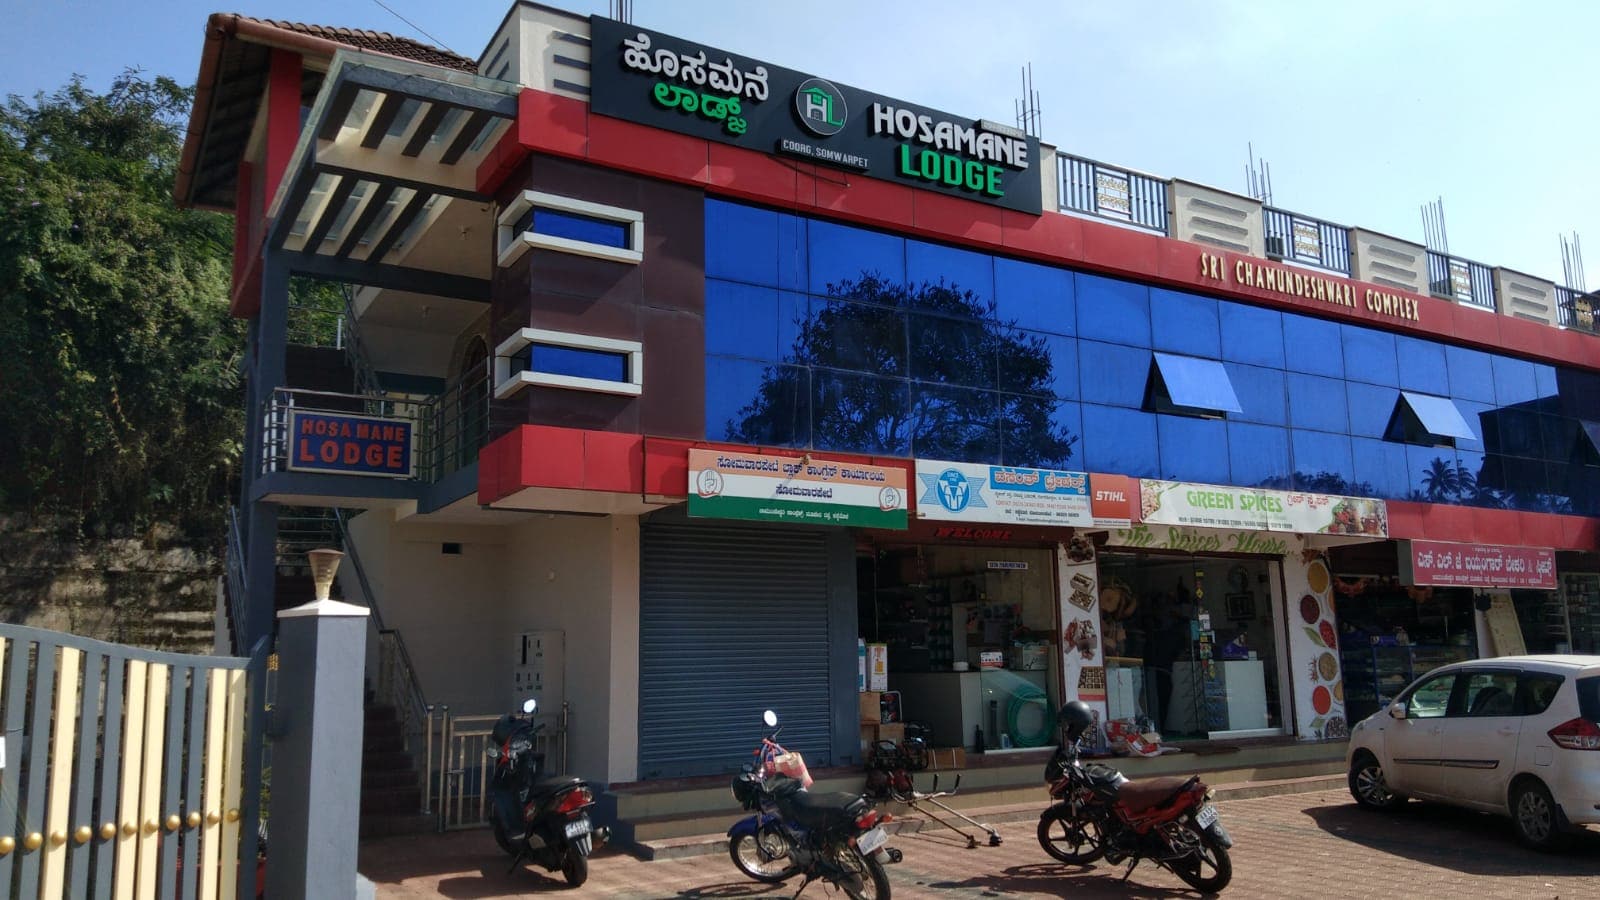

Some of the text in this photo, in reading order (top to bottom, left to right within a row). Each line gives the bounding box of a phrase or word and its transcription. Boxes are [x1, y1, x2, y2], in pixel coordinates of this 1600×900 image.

[623, 33, 769, 101] ಹೊಸಮನೆ
[654, 82, 748, 134] ಲಾಡ್ಜ್
[874, 102, 1029, 169] HOSAMANE
[783, 139, 869, 167] COORG, SOMWARPET
[901, 144, 1005, 196] LODGE
[1201, 253, 1420, 321] SRI CHAMUNDESHWARI COMPLEX
[302, 419, 405, 442] HOSA MANE
[300, 439, 403, 468] LODGE
[717, 456, 779, 472] ಸೋಮವಾರಪೇಟೆ
[841, 469, 886, 482] ಕಾರ್ಯಾಲಯ
[776, 484, 833, 498] ಸೋಮವಾರಪೇಟೆ
[1096, 490, 1126, 502] STIHL
[1186, 490, 1283, 513] GREEN SPICES
[936, 527, 1012, 540] WELCOME
[1118, 525, 1154, 546] The
[1162, 526, 1222, 552] Spices
